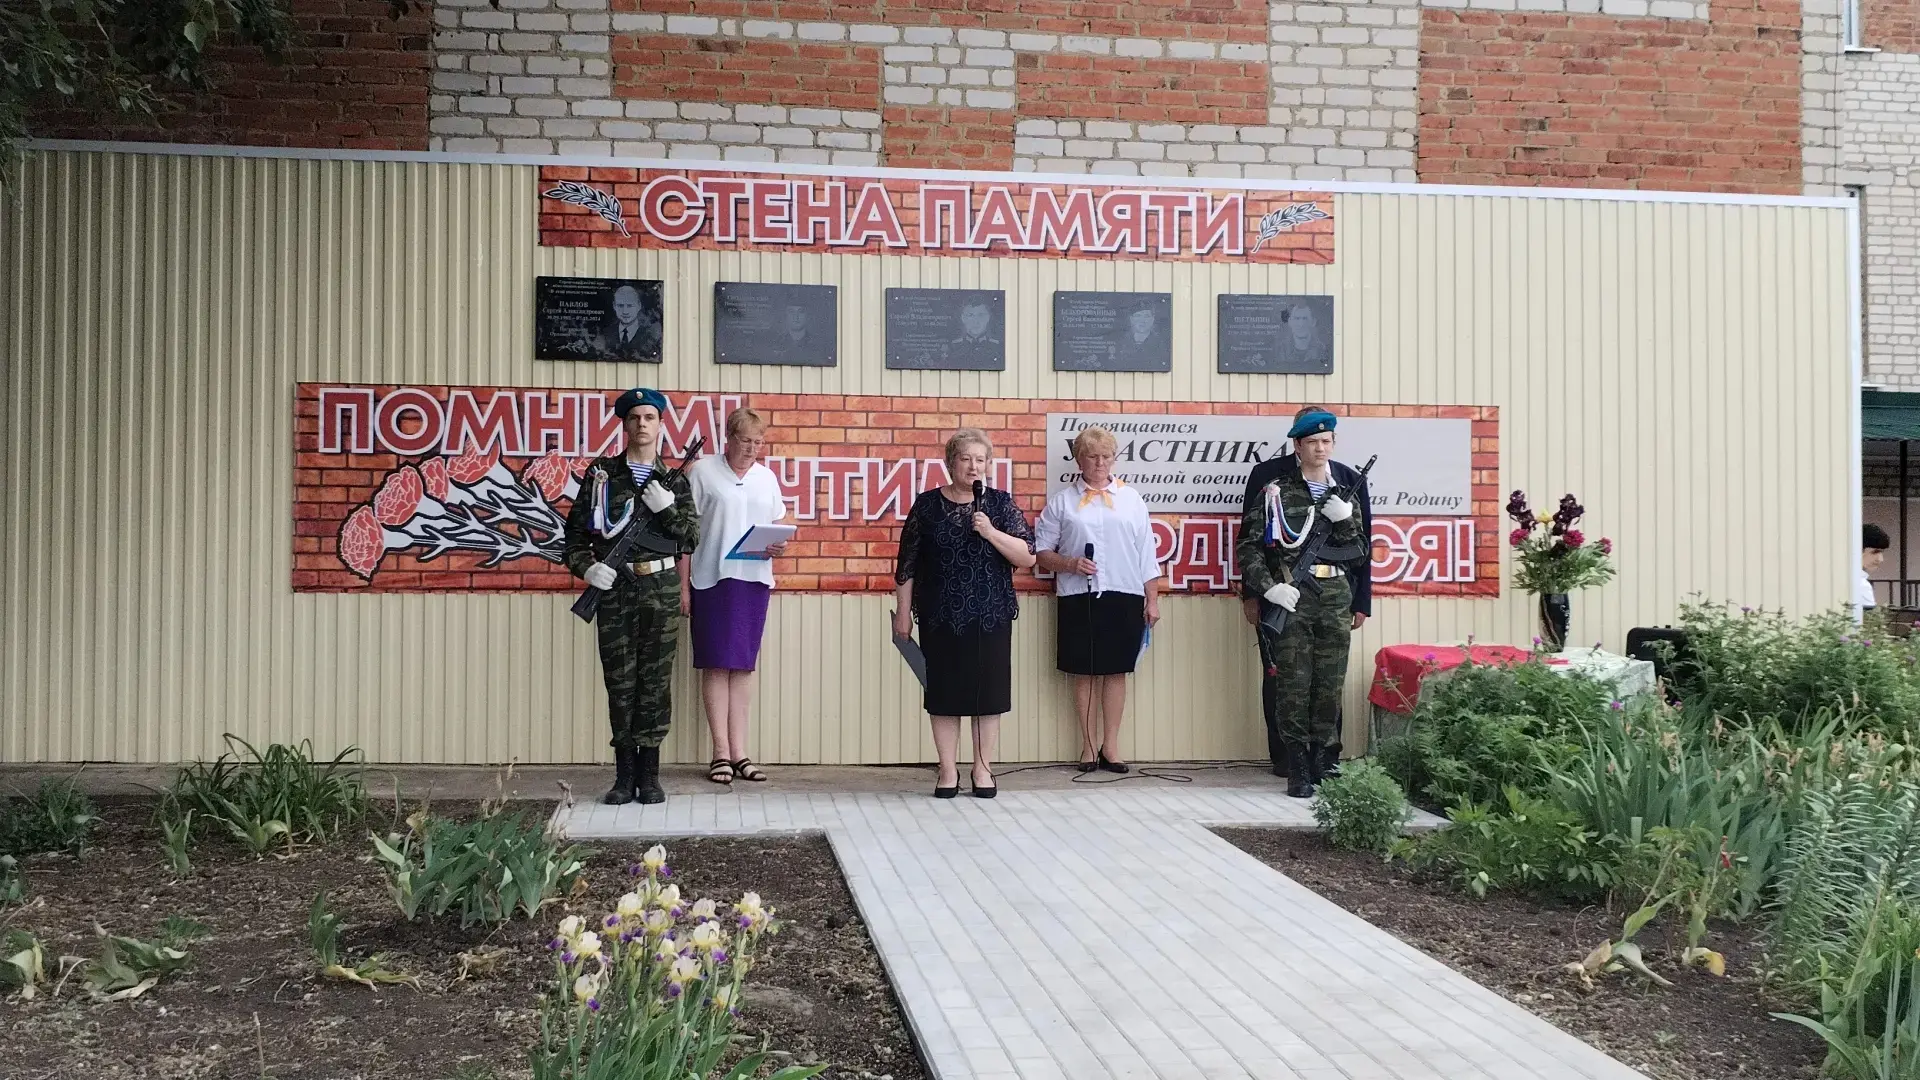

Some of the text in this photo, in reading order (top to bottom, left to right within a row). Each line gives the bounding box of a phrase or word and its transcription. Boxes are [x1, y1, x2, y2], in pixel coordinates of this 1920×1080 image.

[640, 175, 1244, 255] СТЕНА ПАМЯТИ
[559, 300, 589, 308] ПАВЛОВ
[1063, 438, 1289, 463] УАСТНИКА
[1395, 491, 1463, 510] Родину
